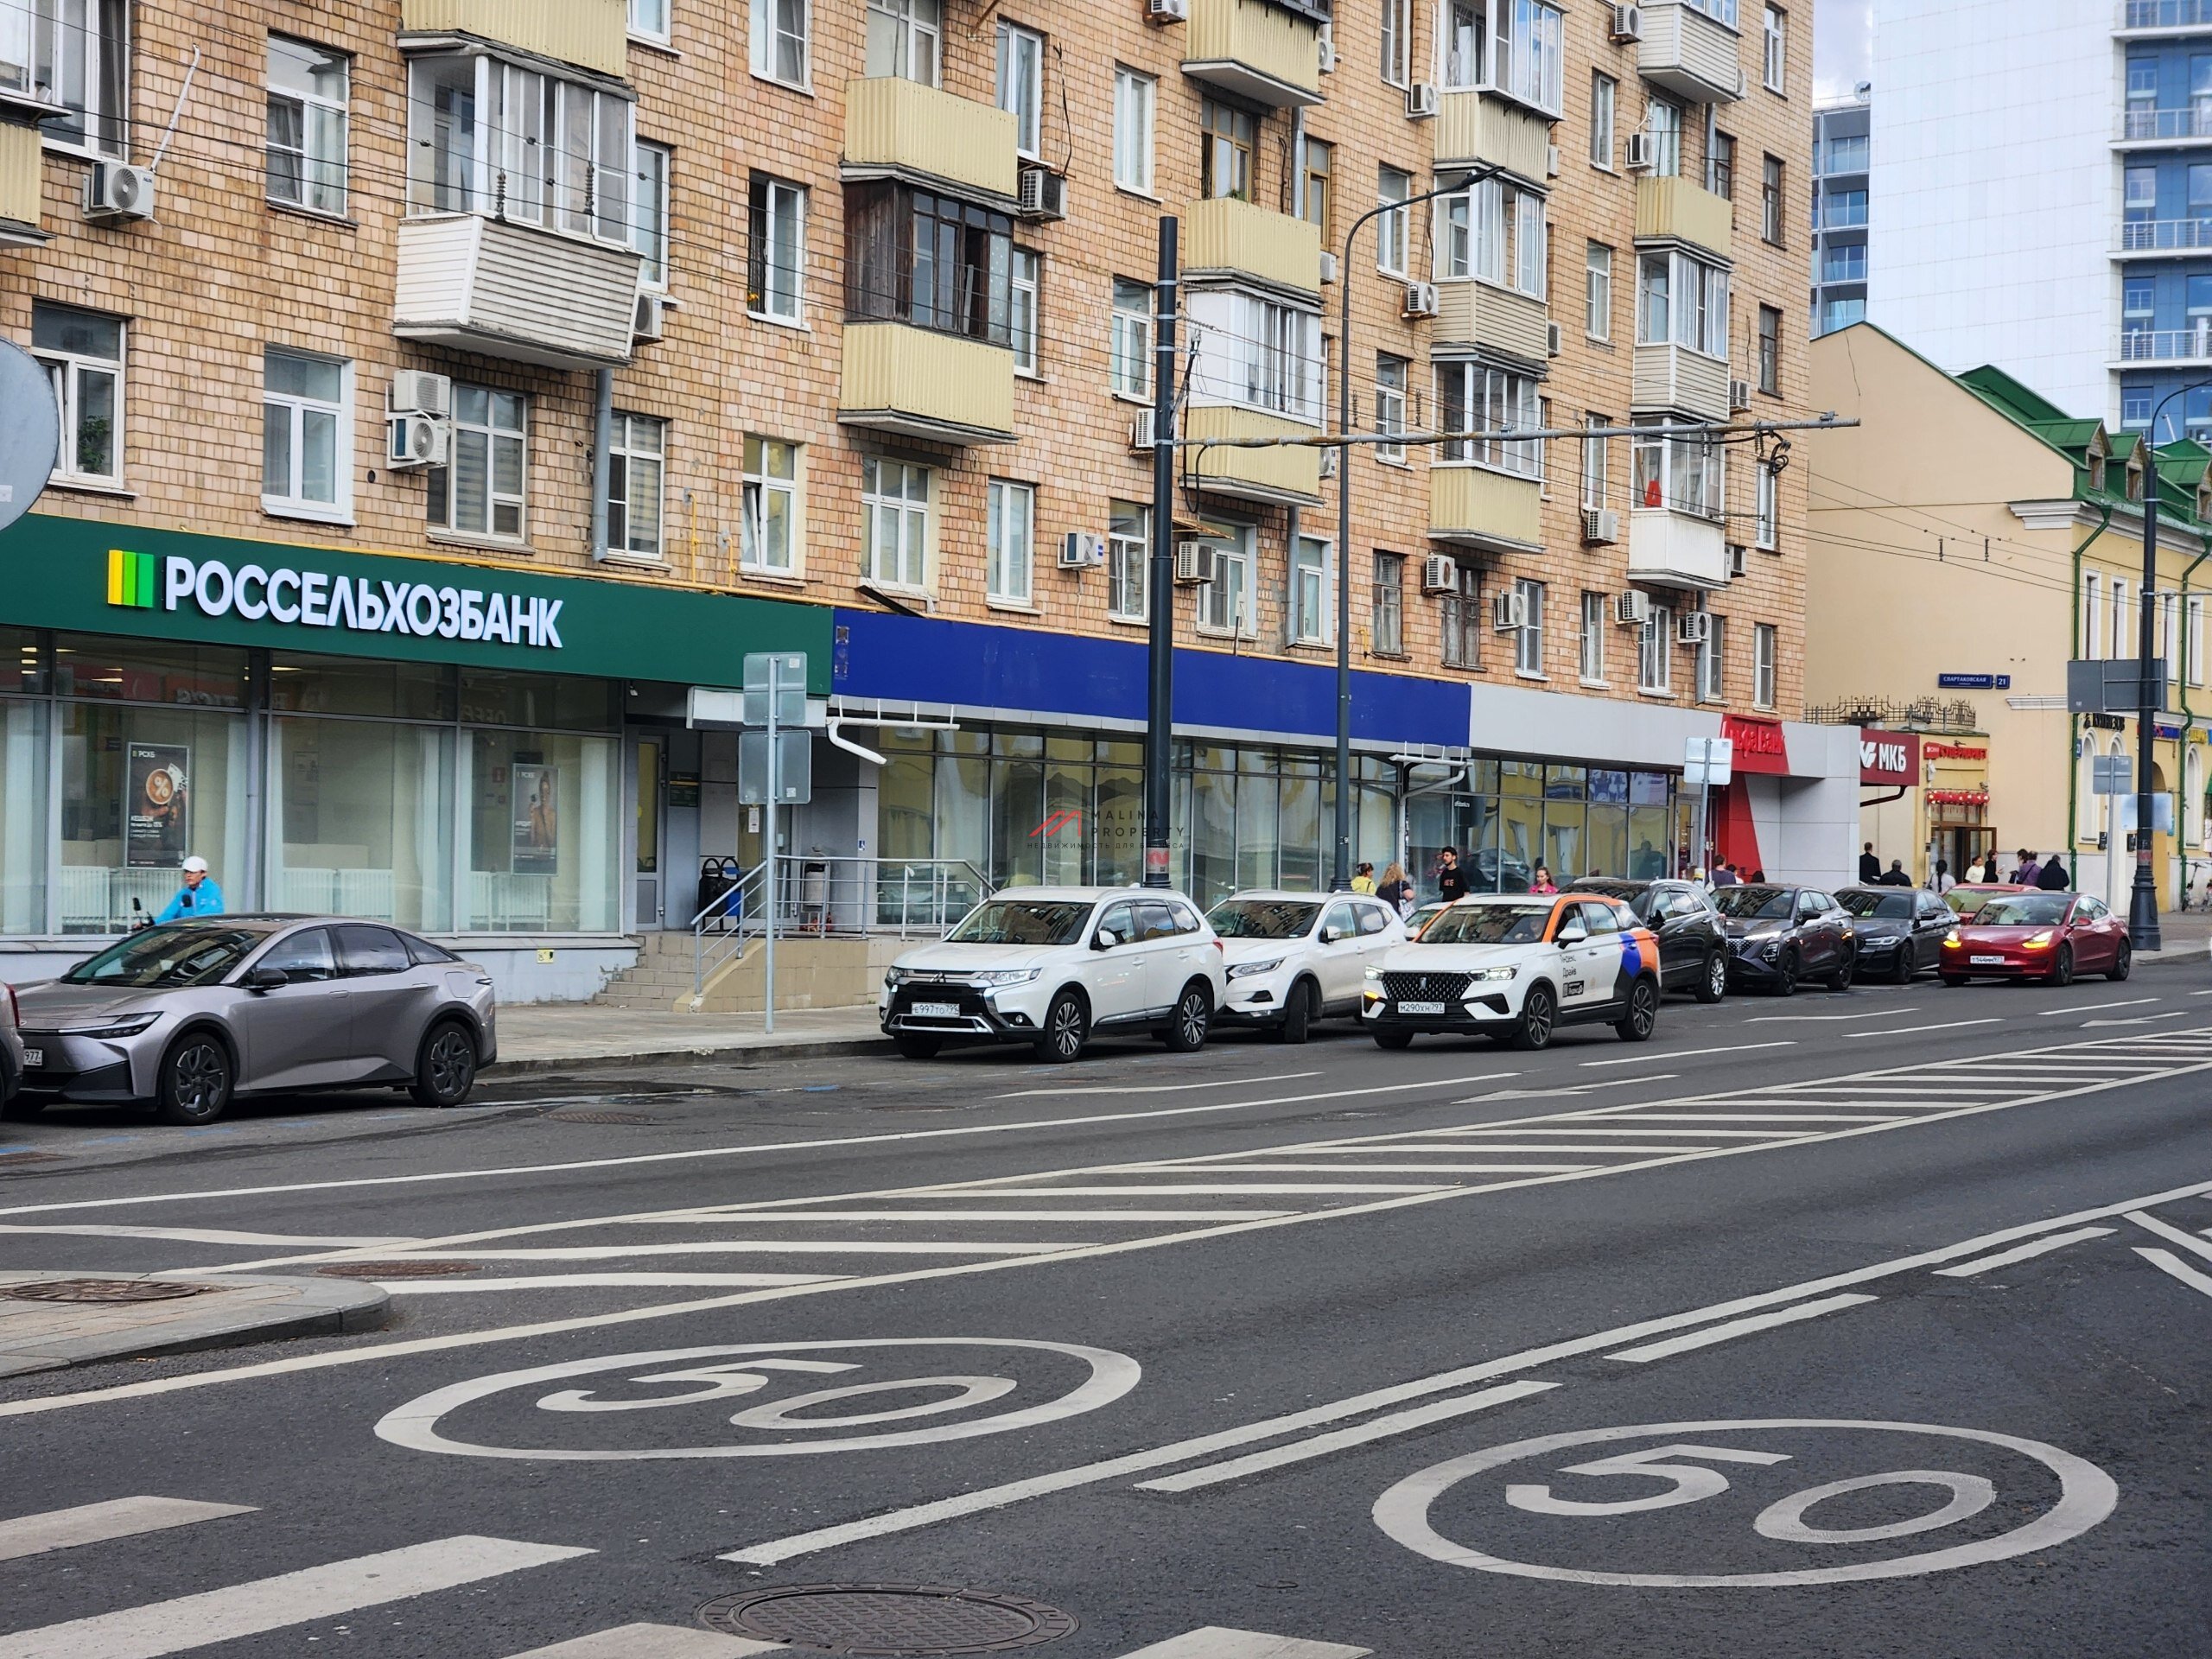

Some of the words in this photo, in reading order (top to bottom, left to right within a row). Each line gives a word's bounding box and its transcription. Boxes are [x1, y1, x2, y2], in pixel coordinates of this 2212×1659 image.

[165, 556, 563, 648] РОССЕЛЬХОЗБАНК
[1879, 743, 1907, 772] МКБ
[536, 1358, 1017, 1430] 50
[1505, 1444, 1997, 1543] 50
